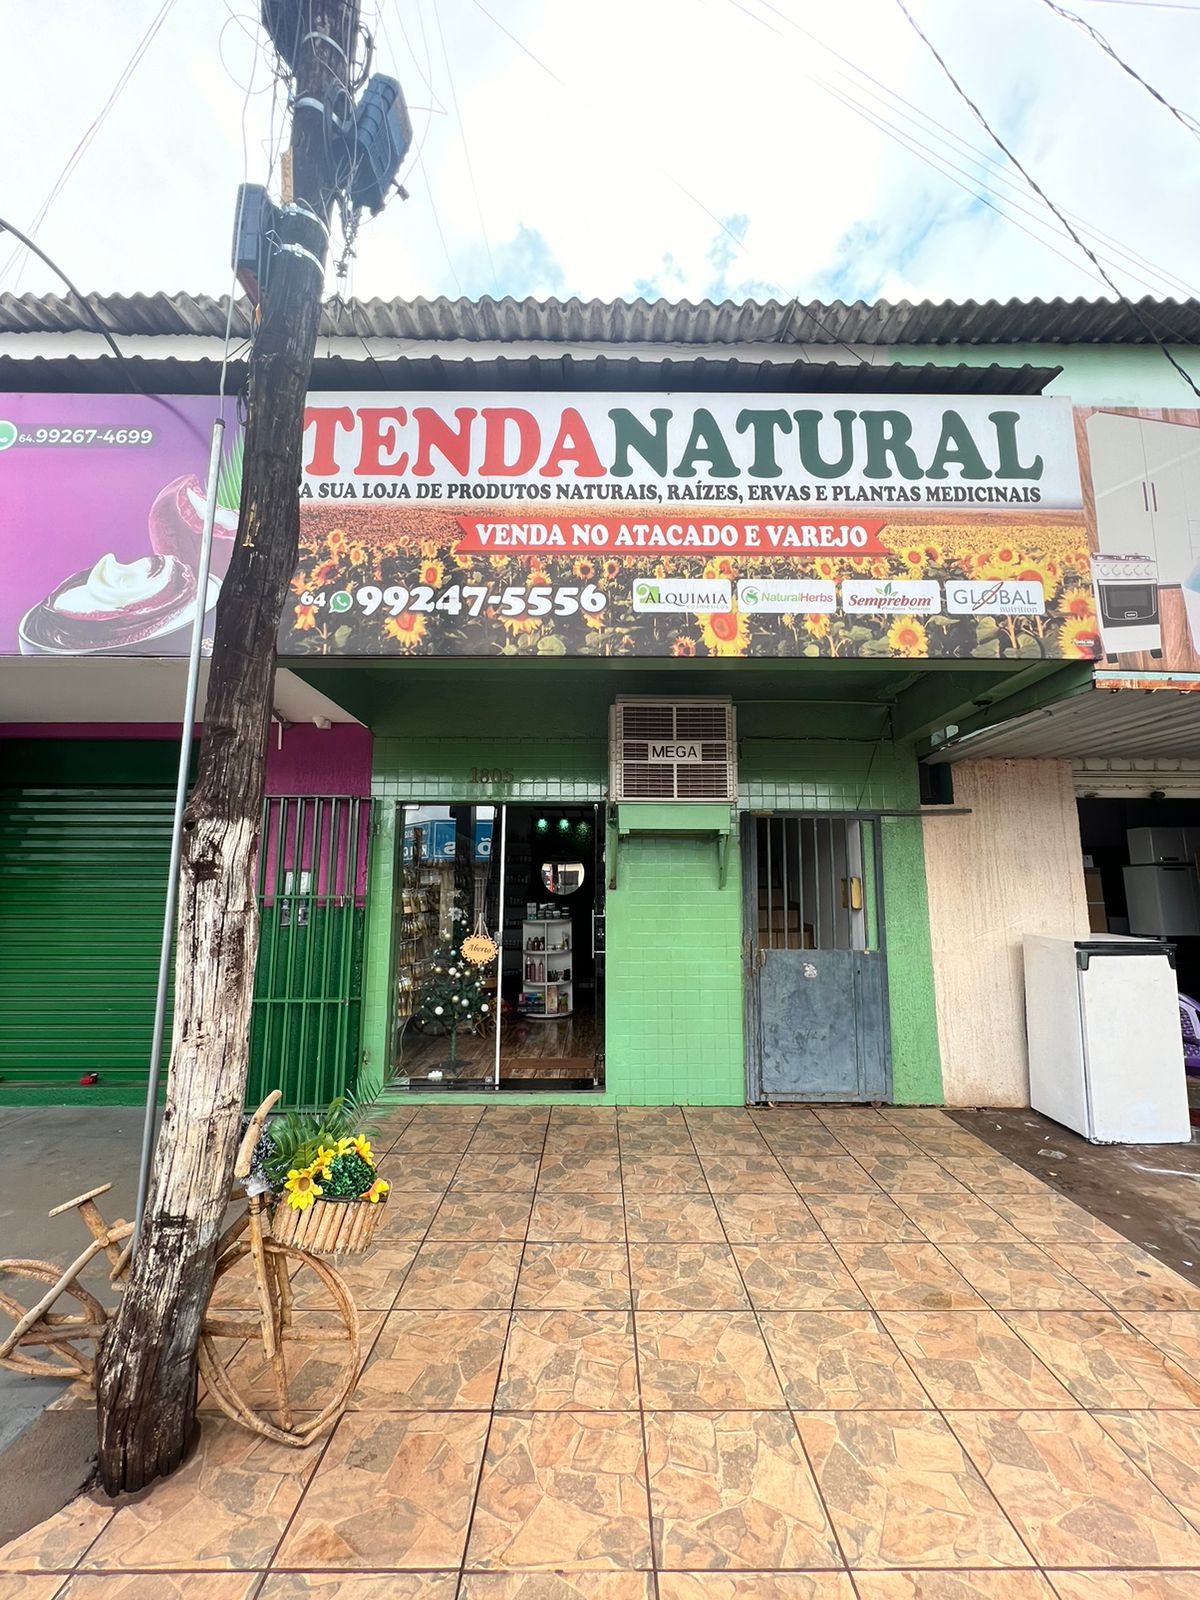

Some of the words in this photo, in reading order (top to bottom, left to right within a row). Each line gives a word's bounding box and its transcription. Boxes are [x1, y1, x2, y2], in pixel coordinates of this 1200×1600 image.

[300, 483, 313, 498] A
[318, 483, 357, 498] SUA
[362, 483, 411, 499] LOJA
[416, 483, 442, 499] DE
[447, 483, 551, 500] PRODUTOS
[556, 484, 663, 503] NATURAIS,
[667, 481, 744, 504] RAÍZES,
[747, 485, 811, 501] ERVAS
[816, 486, 828, 501] E
[832, 486, 921, 502] PLANTAS
[926, 487, 1041, 503] MEDICINAIS
[475, 524, 565, 546] VENDA
[571, 525, 609, 546] NO
[614, 525, 738, 547] ATACADO
[745, 526, 760, 547] E
[765, 526, 868, 548] VAREJO
[300, 591, 327, 607] 64
[356, 585, 607, 616] 99247-5556
[848, 594, 932, 609] Semprebom
[953, 589, 1037, 606] GLOBAL
[1000, 606, 1038, 614] nutrition
[652, 745, 698, 758] MEGA
